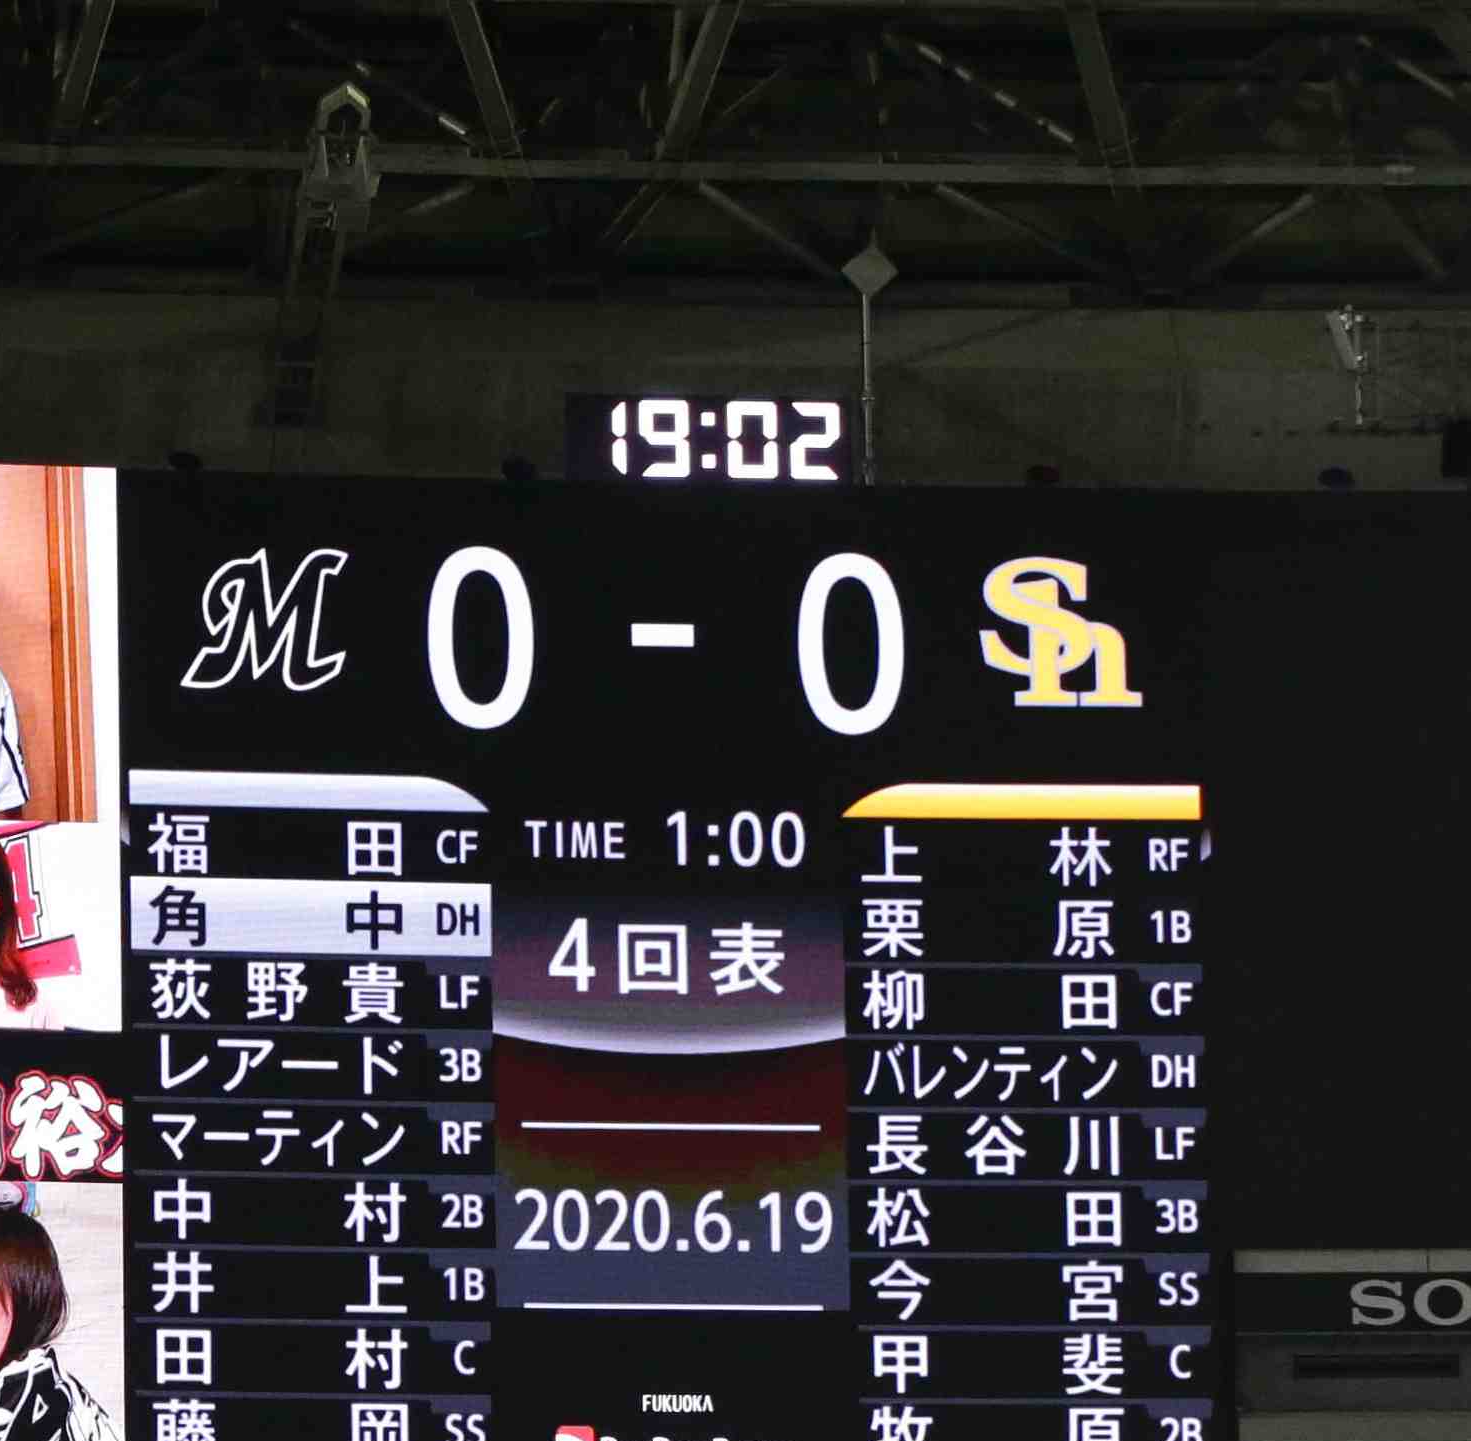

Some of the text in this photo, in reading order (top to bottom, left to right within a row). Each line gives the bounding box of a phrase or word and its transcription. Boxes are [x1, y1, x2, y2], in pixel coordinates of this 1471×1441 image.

[611, 398, 842, 481] 19:02
[427, 545, 535, 730] 0
[798, 552, 905, 735] 0
[436, 830, 478, 864] CF
[524, 810, 806, 868] TIME 1:00
[1147, 838, 1189, 871] RF
[436, 903, 480, 936] DH
[1149, 910, 1192, 944] 1B
[548, 916, 786, 995] 4回表
[439, 975, 480, 1010] LF
[1150, 981, 1193, 1017] CF
[160, 1034, 482, 1095] レアード 3B
[864, 1042, 1196, 1102] バレンティン DH
[152, 1110, 483, 1166] マーティン RF
[1155, 1126, 1196, 1161] LF
[442, 1193, 485, 1229] 2B
[513, 1187, 833, 1254] 2020.6.19
[1155, 1199, 1199, 1234] 3B
[443, 1267, 485, 1302] 1B
[1158, 1271, 1200, 1306] SS
[453, 1340, 476, 1375] C
[1169, 1344, 1192, 1379] C
[642, 1394, 714, 1413] FUKUOKA
